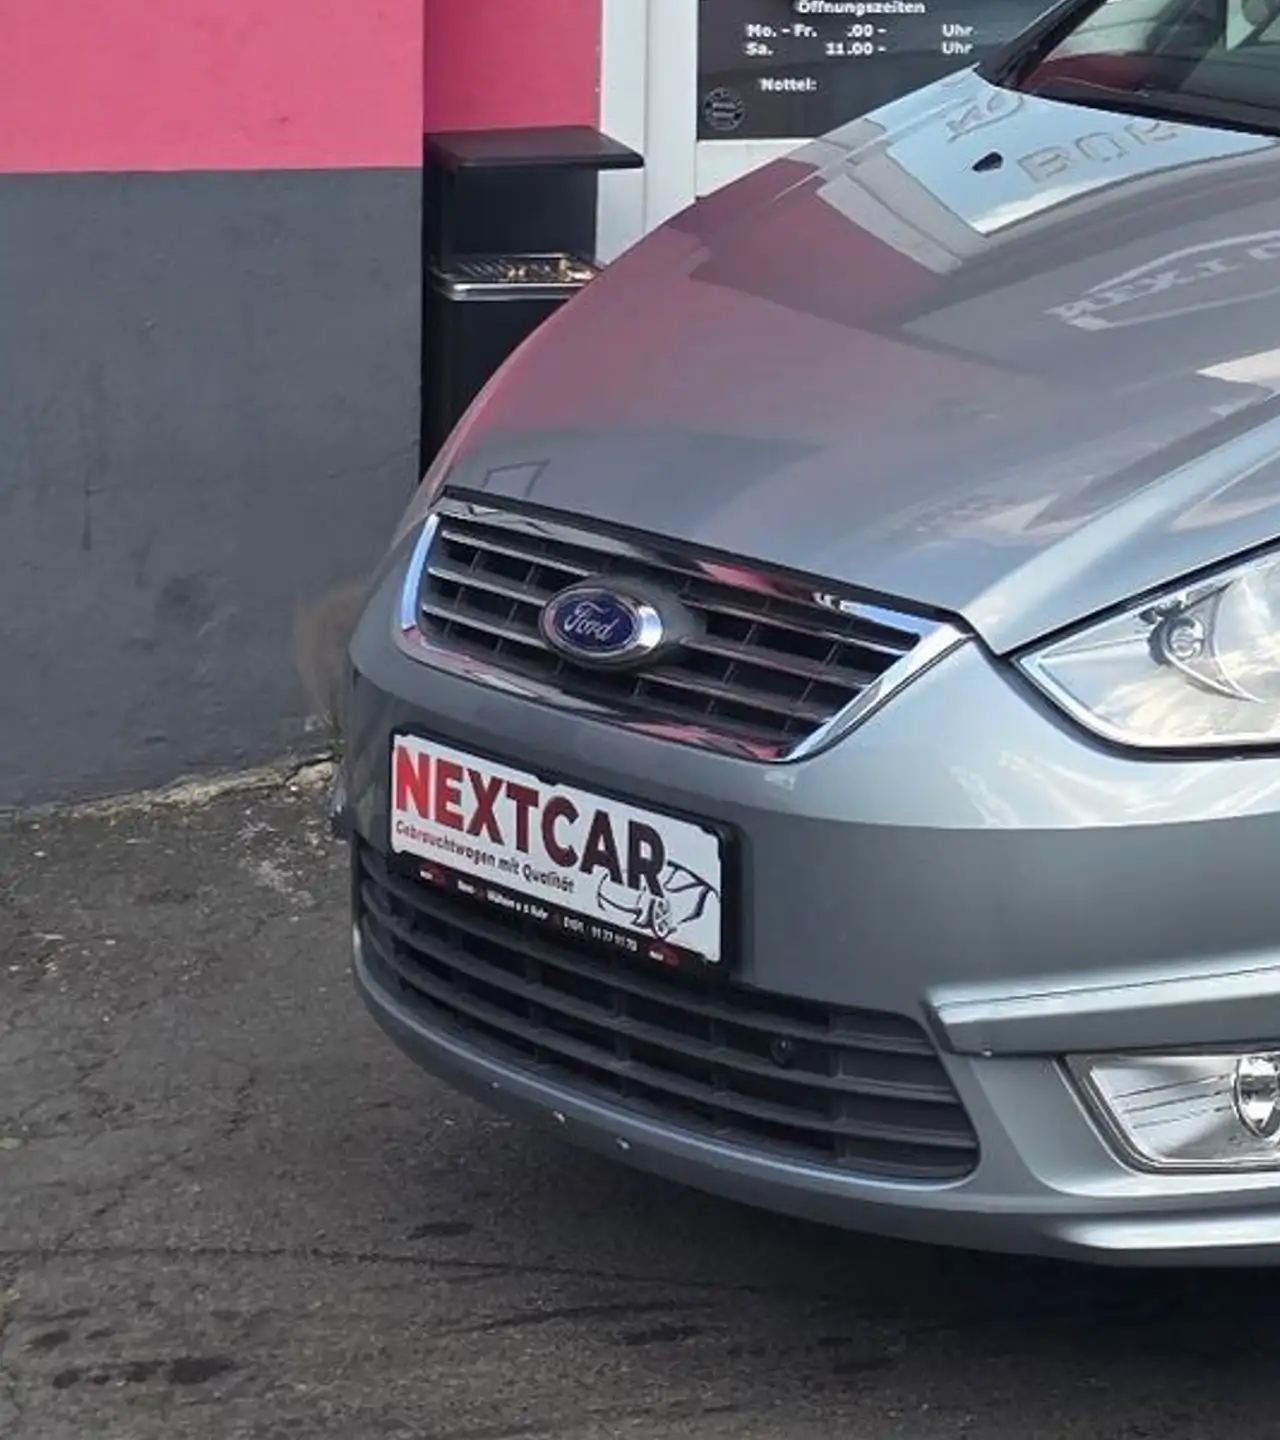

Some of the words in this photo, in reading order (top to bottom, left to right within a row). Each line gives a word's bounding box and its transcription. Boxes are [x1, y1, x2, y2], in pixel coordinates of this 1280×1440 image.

[745, 23, 777, 38] Mo.
[794, 23, 818, 38] Fr.
[942, 23, 974, 37] Uhr
[745, 41, 774, 56] Sa.
[942, 41, 974, 55] Uhr
[563, 600, 621, 641] Ford
[395, 743, 666, 899] NEXTCAR
